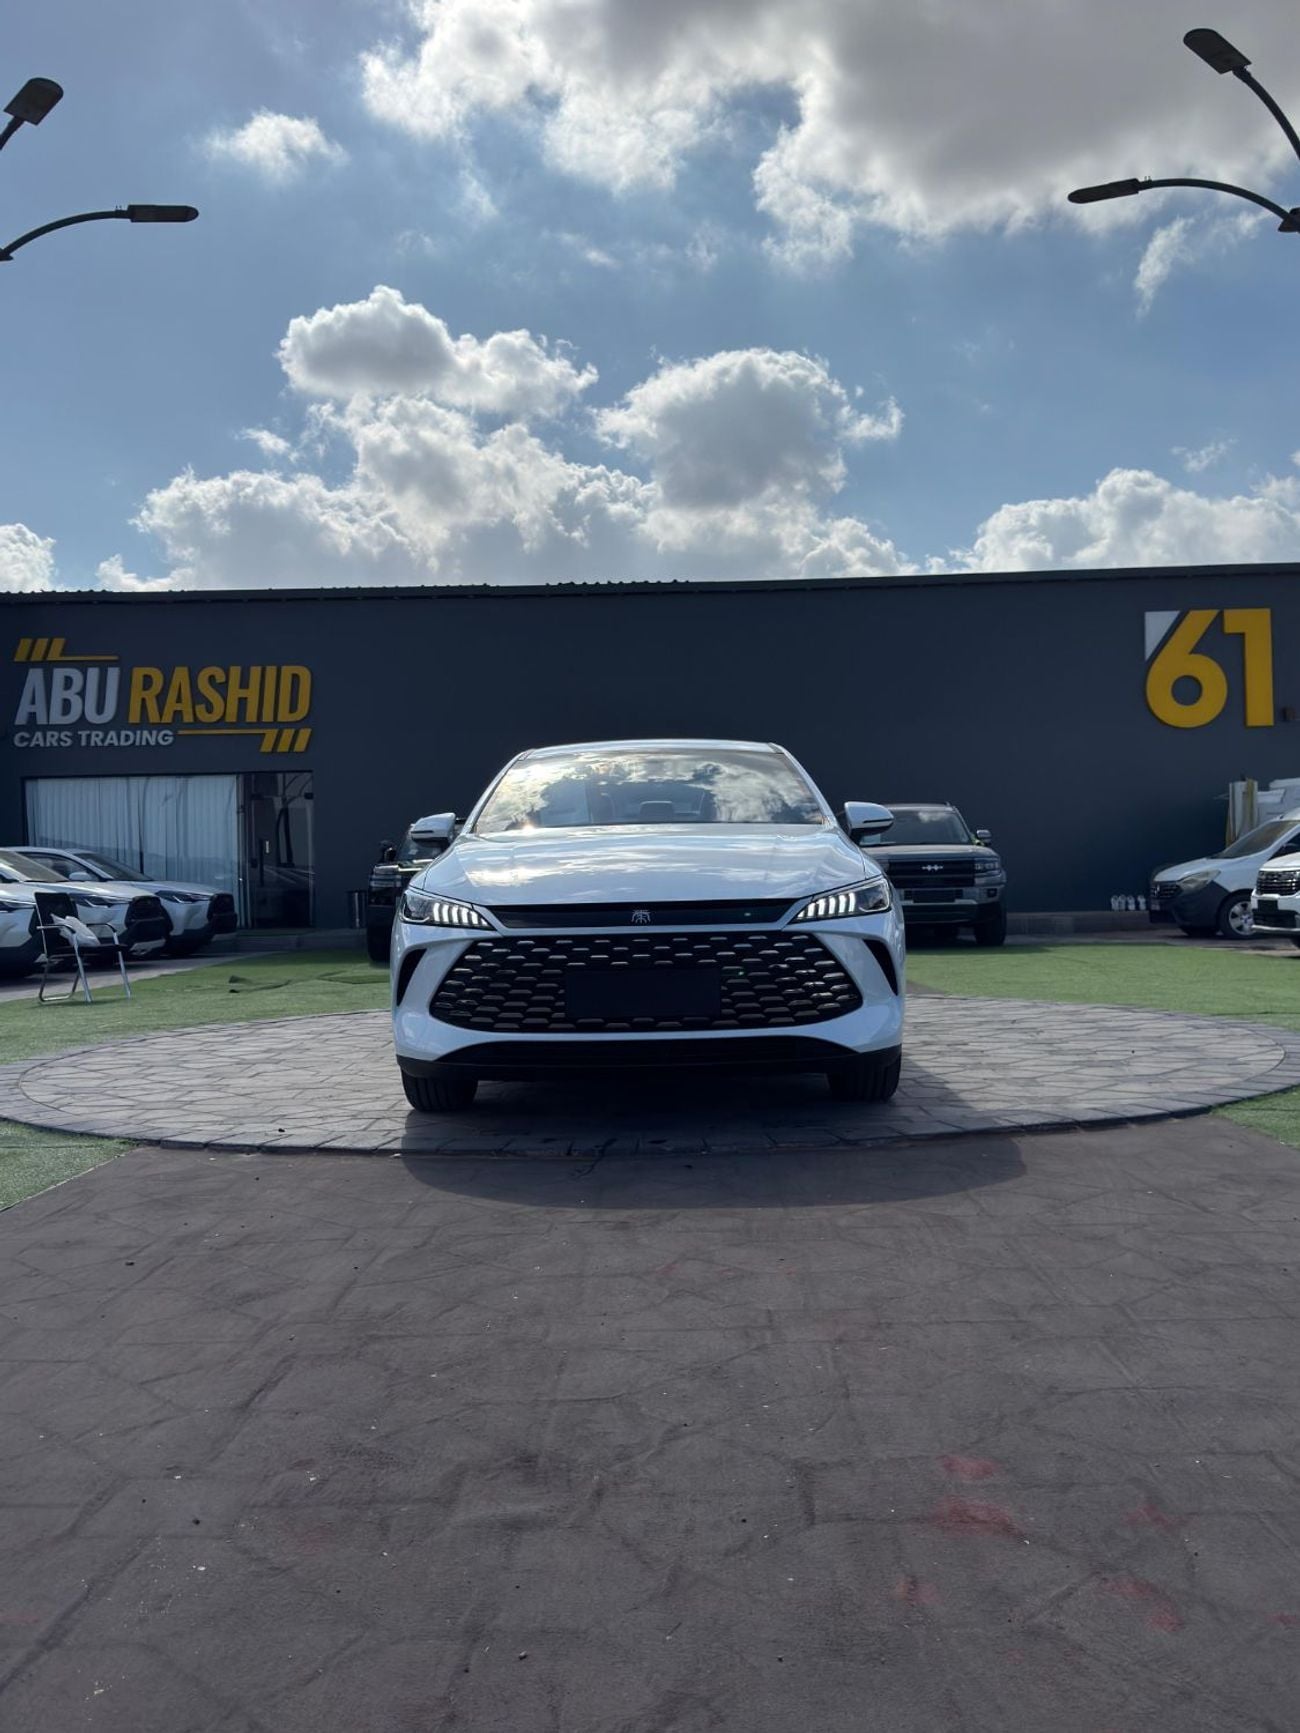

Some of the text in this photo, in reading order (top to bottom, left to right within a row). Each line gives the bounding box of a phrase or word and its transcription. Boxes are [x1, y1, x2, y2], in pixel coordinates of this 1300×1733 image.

[14, 665, 312, 726] ABU RASHID
[1146, 608, 1274, 729] 61
[13, 729, 175, 748] CARS TRADING
